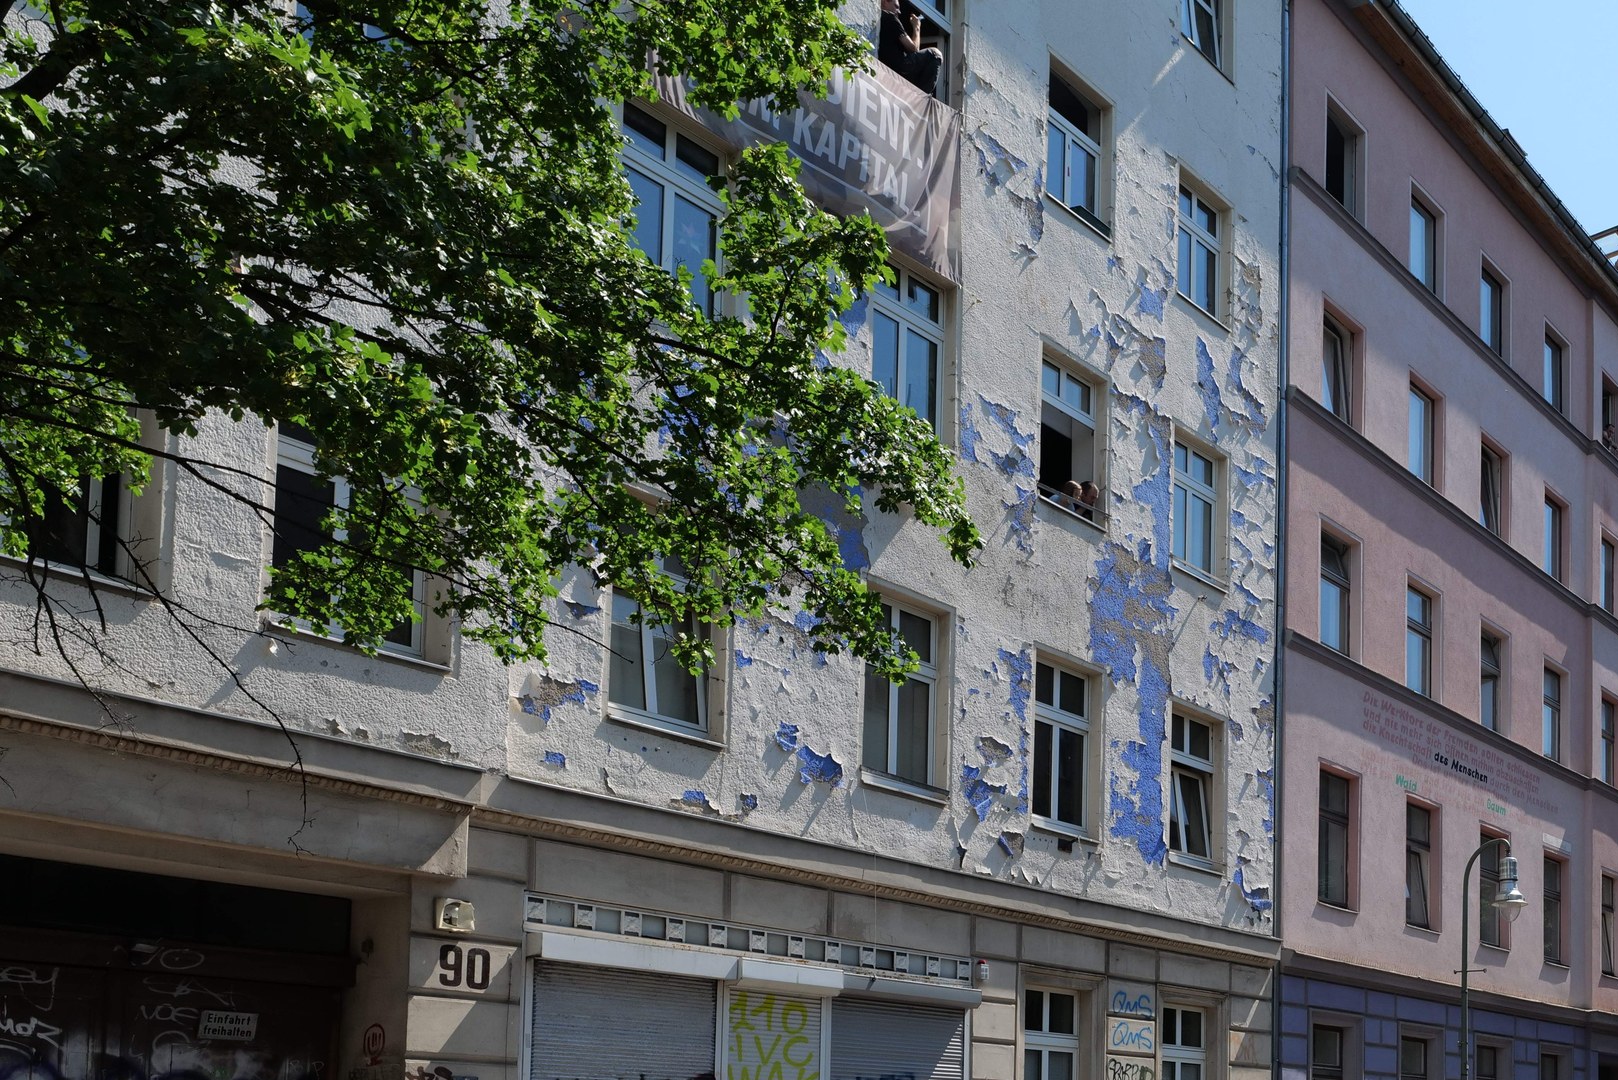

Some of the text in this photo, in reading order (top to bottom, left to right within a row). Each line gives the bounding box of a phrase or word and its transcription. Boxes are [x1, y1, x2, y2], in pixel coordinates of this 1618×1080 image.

[1433, 751, 1449, 766] des
[1450, 758, 1489, 784] Menschen
[438, 944, 491, 991] 90
[206, 1012, 252, 1026] Einfahrt
[202, 1024, 252, 1038] freihalten
